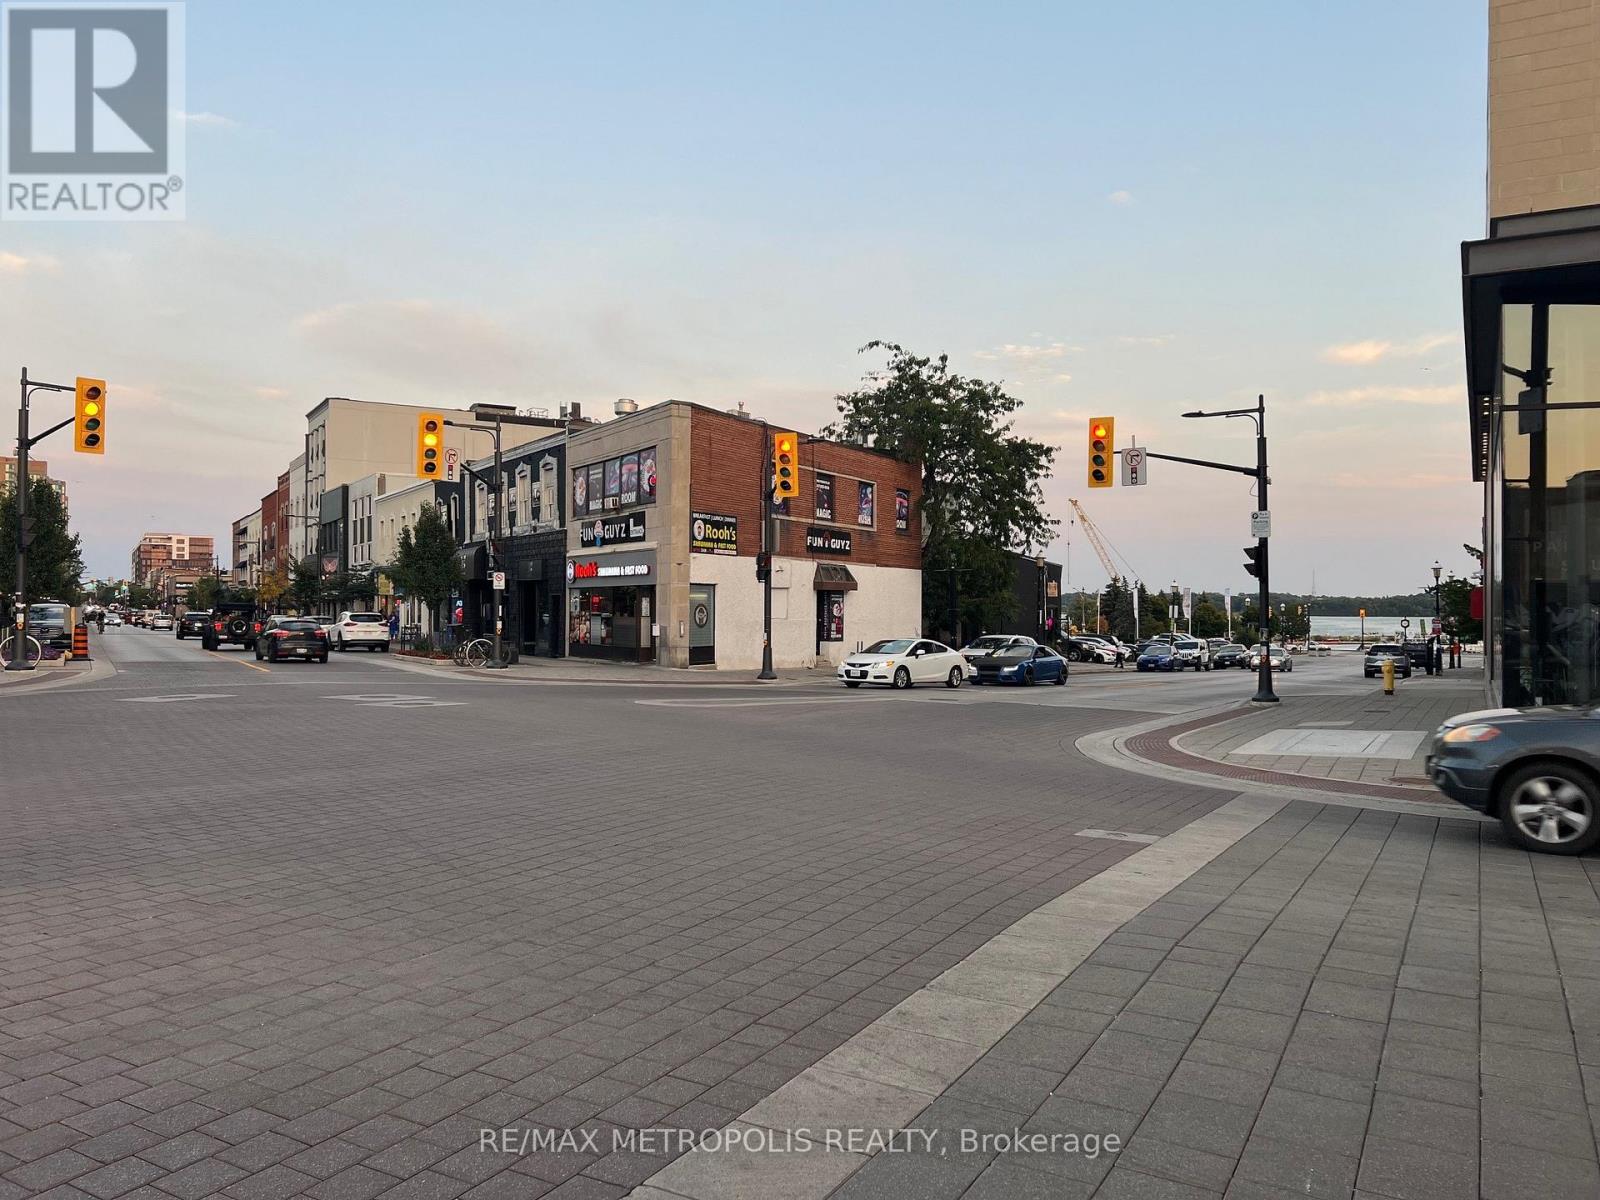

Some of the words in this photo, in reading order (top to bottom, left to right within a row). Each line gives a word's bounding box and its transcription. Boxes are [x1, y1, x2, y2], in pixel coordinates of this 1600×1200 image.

[580, 527, 595, 541] FUN
[604, 523, 626, 539] GUYZ
[705, 524, 736, 541] Rooh's
[807, 536, 823, 547] FUN
[830, 538, 850, 550] GUYZ
